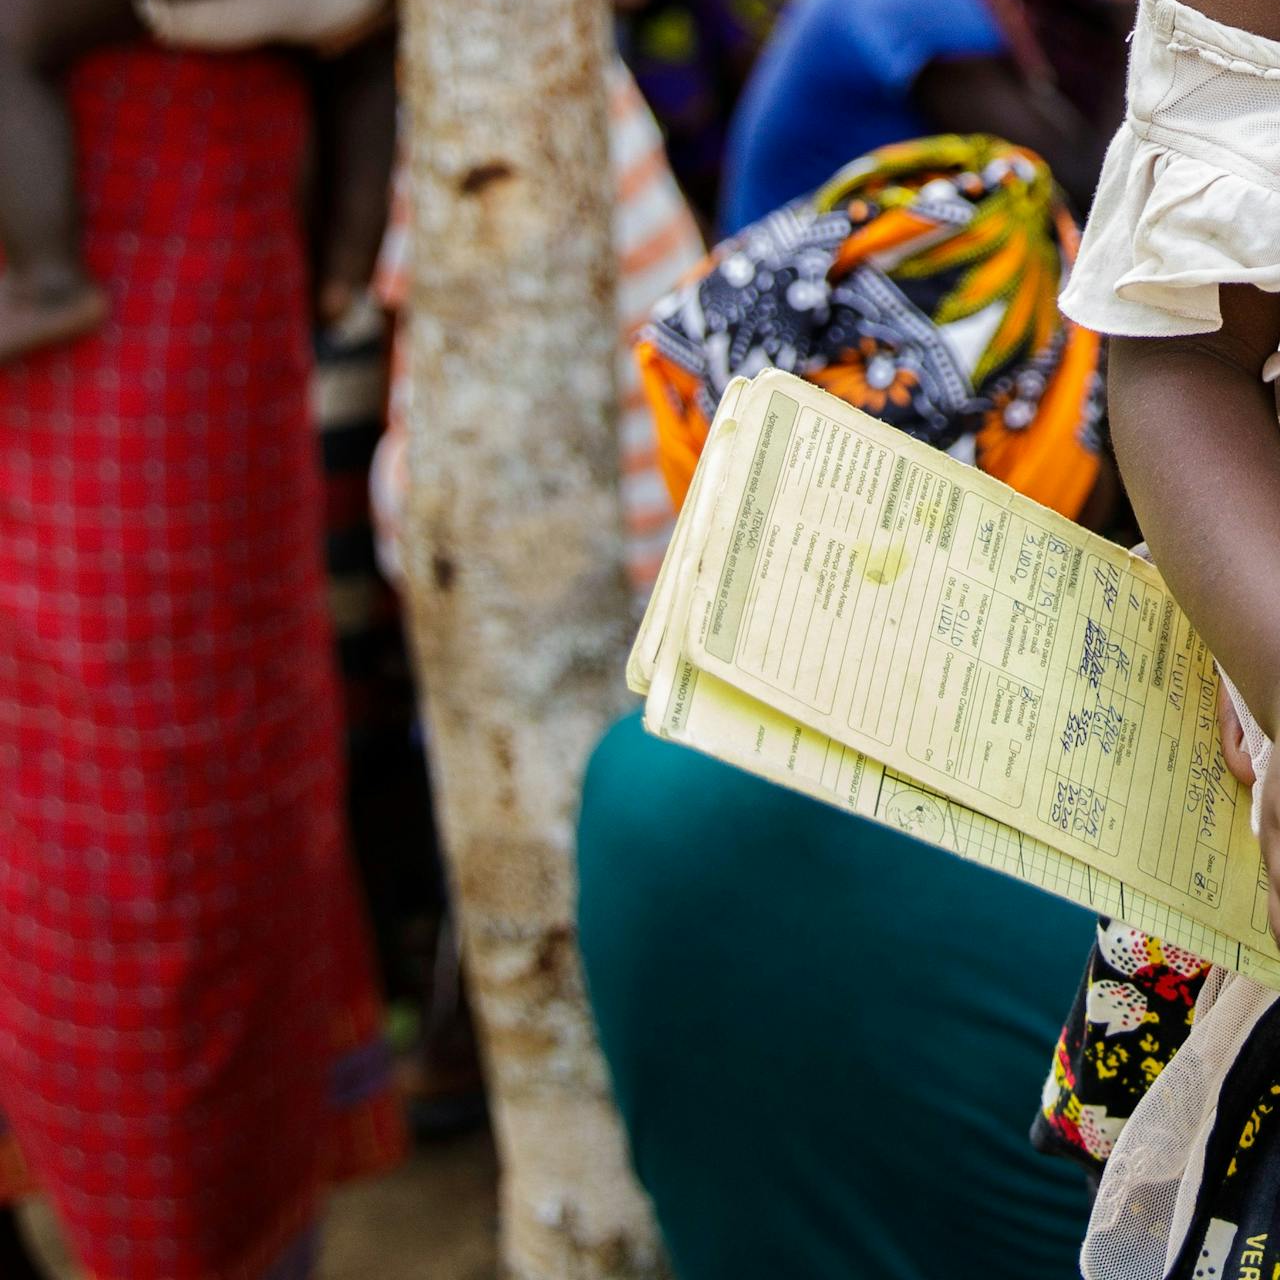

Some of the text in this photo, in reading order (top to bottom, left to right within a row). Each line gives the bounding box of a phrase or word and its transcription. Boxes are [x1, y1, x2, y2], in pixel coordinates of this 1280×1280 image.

[789, 436, 804, 468] Falecidos
[804, 416, 822, 460] Irmãos Vivos
[825, 424, 839, 454] Doenças
[837, 431, 850, 461] Diabetes
[843, 438, 862, 492] Asma brônquica
[862, 443, 874, 469] Anemia
[866, 449, 886, 504] Doença alérgica
[881, 455, 906, 529] HISTÓRIA FAMILIAR
[905, 465, 919, 500] Neonatais
[919, 472, 932, 500] Durante
[934, 479, 946, 507] Durante
[711, 411, 778, 635] Apresente sempre este Cartão de Saúde em todas as Consultas
[896, 516, 905, 531] dias)
[913, 506, 922, 525] parto
[924, 513, 936, 544] gravidez
[939, 486, 961, 548] COMPLICAÇÕES
[760, 524, 780, 579] Causa da morte
[791, 522, 804, 546] Outras
[803, 530, 819, 572] Tuberculose
[988, 510, 1007, 572] Idade Gestacional
[815, 538, 835, 594] Nervoso Central
[822, 542, 845, 610] Doença do Sistema
[948, 576, 956, 586] 05
[1027, 531, 1047, 600] Peso de Nascimento
[1060, 562, 1066, 572] de
[1067, 547, 1083, 588] PERINATAL
[835, 549, 858, 618] Hipertensão Arterial
[961, 582, 969, 593] 01
[1051, 573, 1065, 612] Nascimento
[971, 626, 982, 648] Apgar
[976, 615, 983, 625] de
[1160, 630, 1168, 642] DE
[1001, 612, 1018, 667] Na maternidade
[1017, 624, 1028, 655] caminho
[1029, 623, 1041, 654] Em casa
[1039, 617, 1055, 667] Local do parto
[937, 651, 953, 698] Comprimento
[1153, 643, 1165, 686] VACINAÇÃO
[674, 701, 683, 715] NA
[953, 697, 966, 732] Craneano
[990, 688, 1004, 724] Cesariana
[1003, 694, 1015, 723] Ventosa
[1016, 698, 1027, 726] Normal
[1025, 694, 1040, 741] Tipo de Parto
[924, 747, 933, 761] Cm
[945, 758, 953, 772] Cm
[1051, 781, 1067, 822] 2020
[1061, 784, 1078, 829] 2020
[1084, 797, 1105, 837] 2019
[1206, 853, 1215, 873] Sexo
[1206, 892, 1213, 901] M
